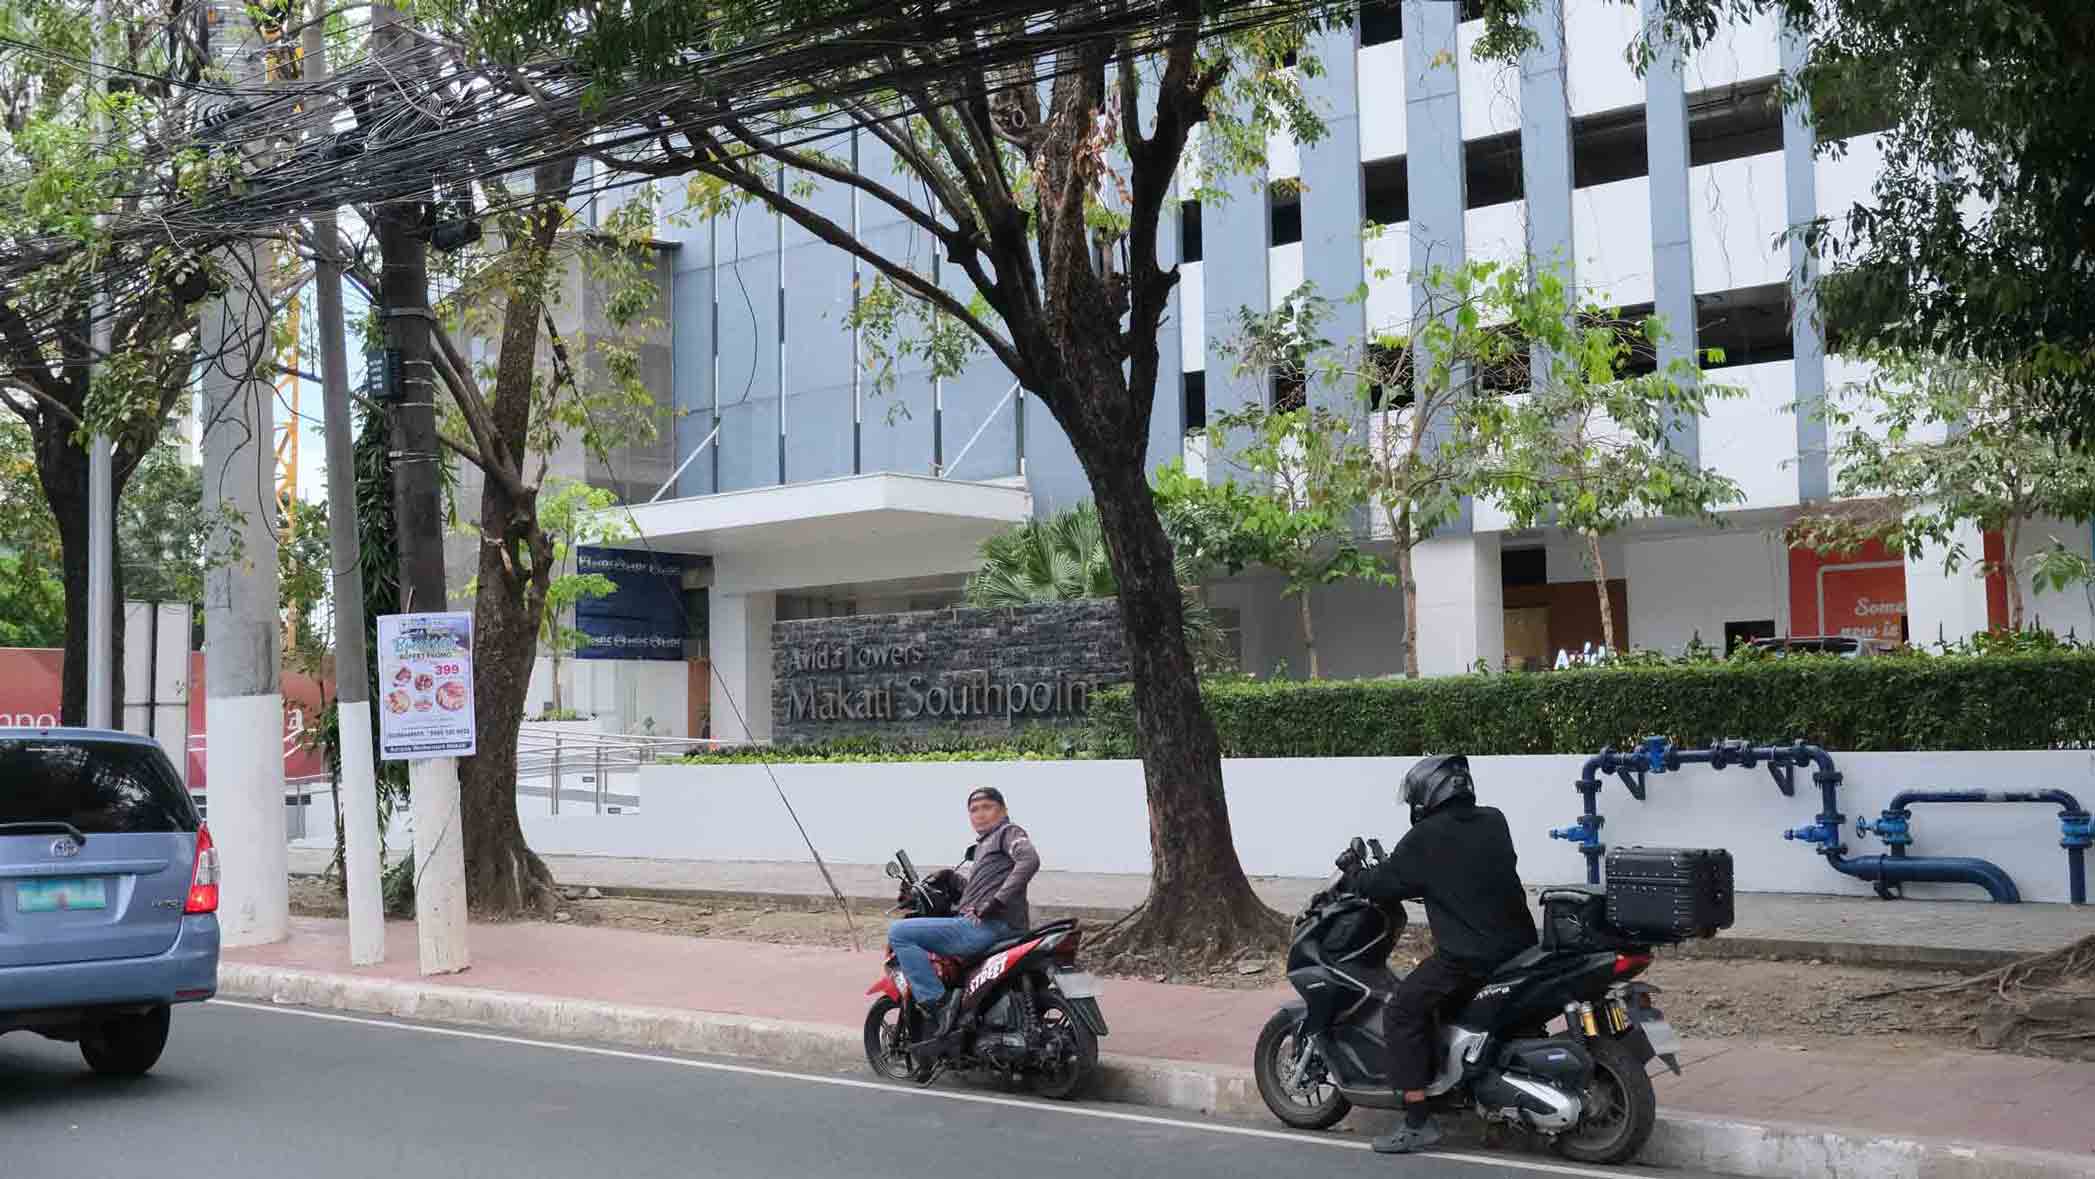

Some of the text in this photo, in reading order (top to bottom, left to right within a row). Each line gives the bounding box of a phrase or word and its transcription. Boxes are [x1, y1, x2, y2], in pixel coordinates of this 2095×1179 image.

[435, 664, 459, 676] 399
[787, 669, 1102, 728] Makati Southpoin
